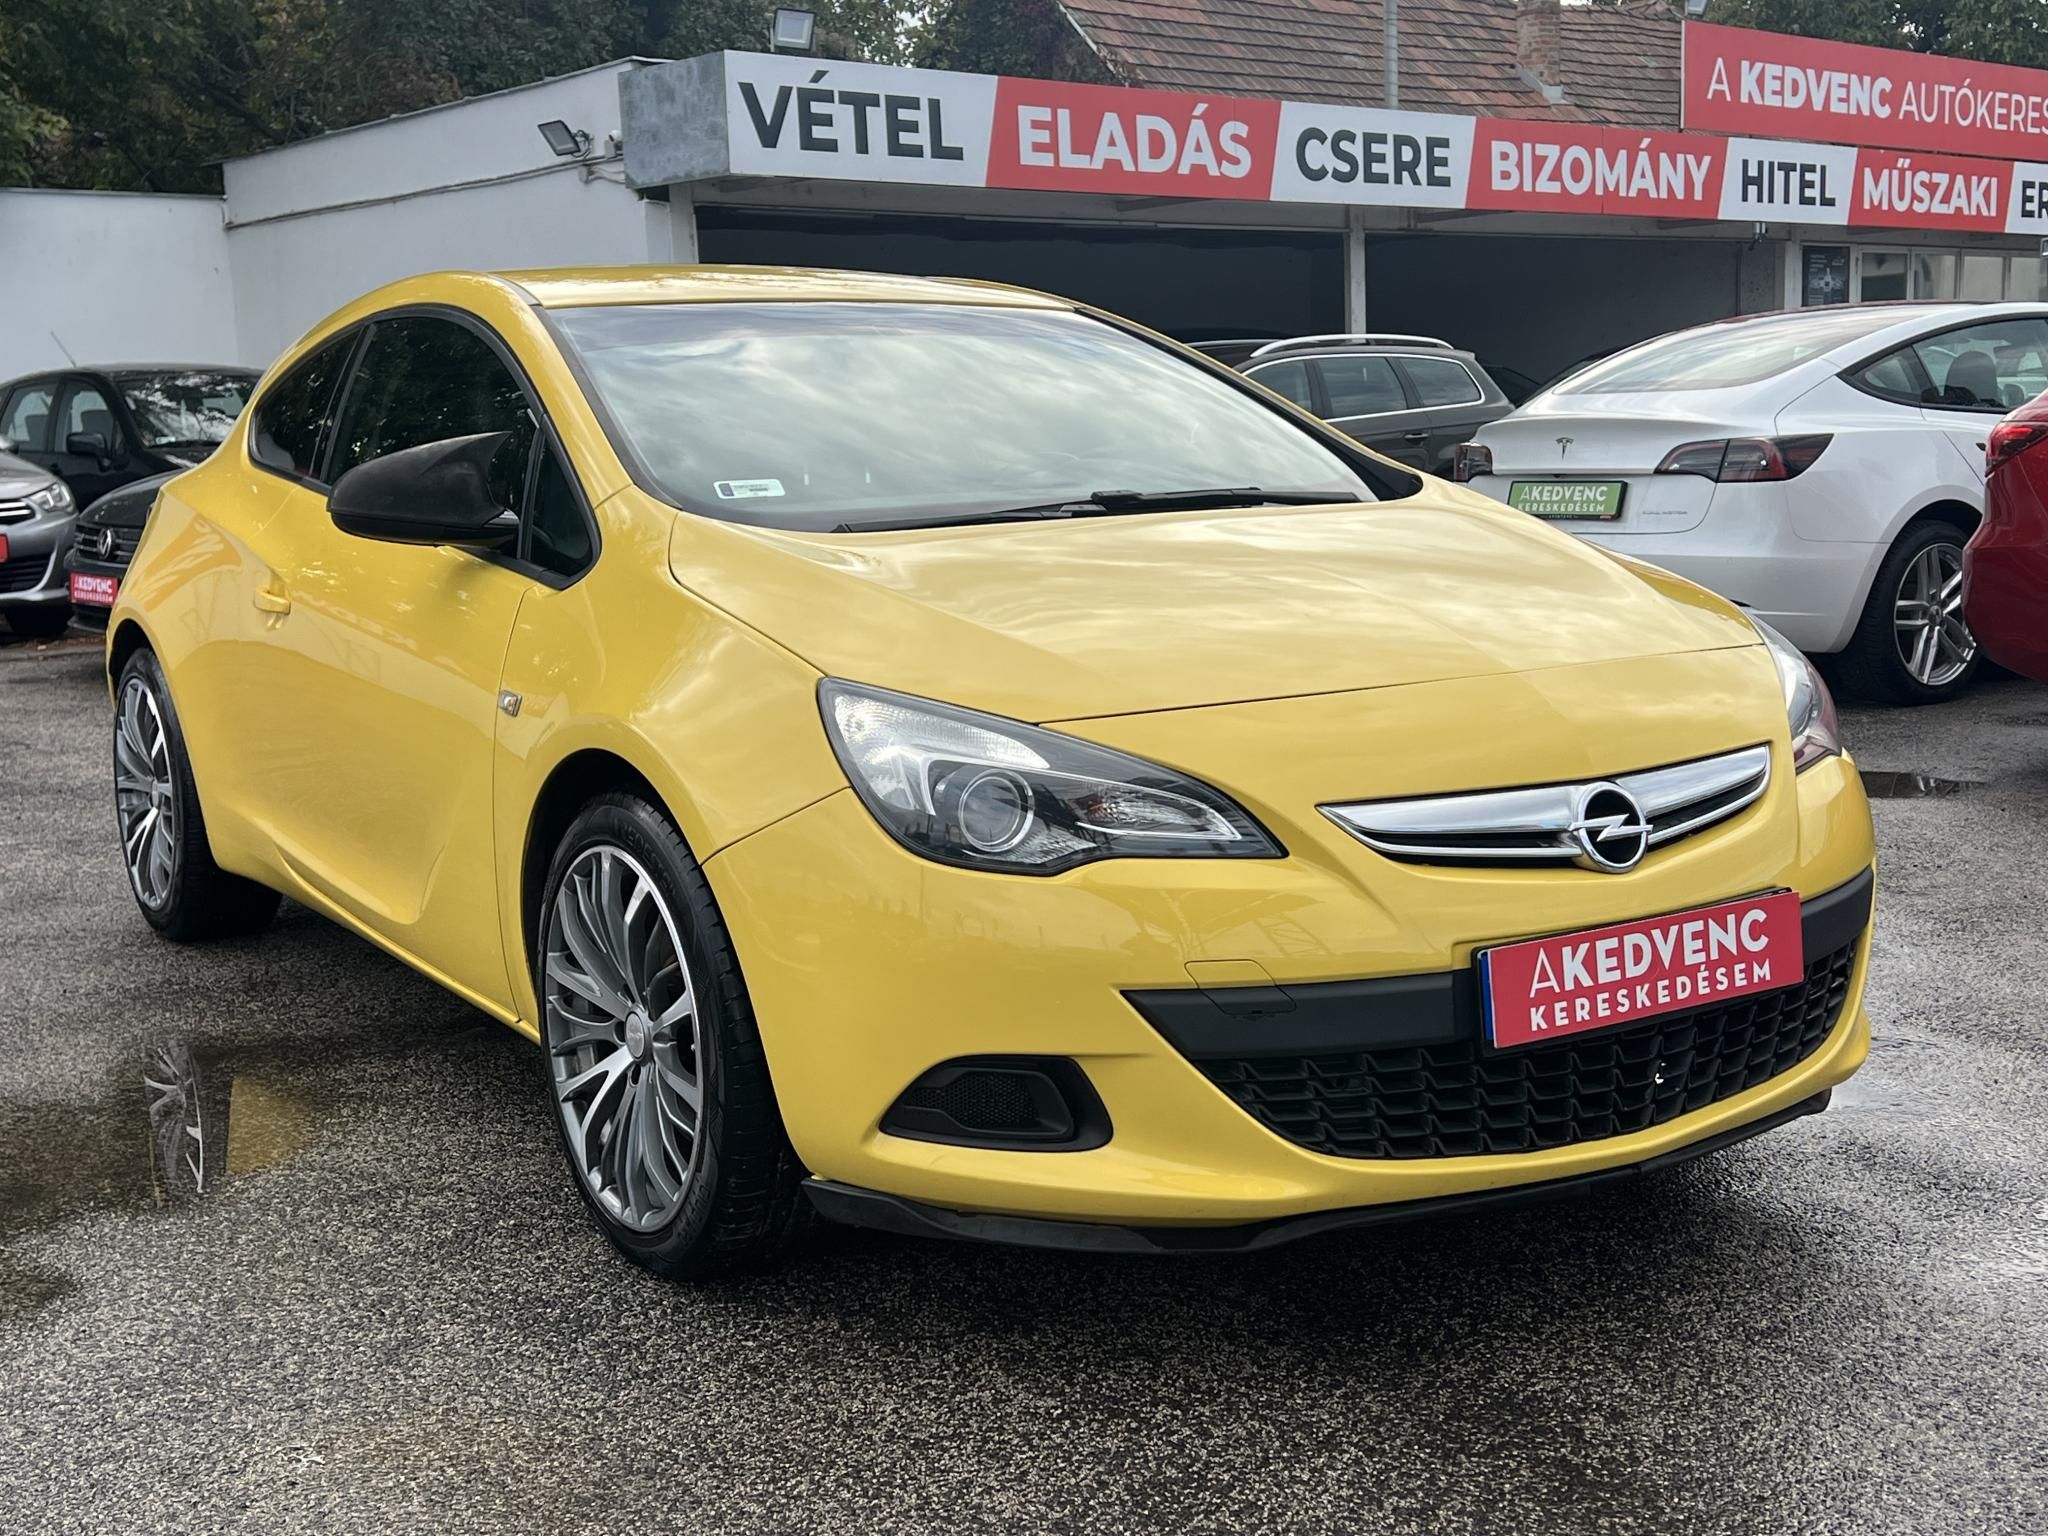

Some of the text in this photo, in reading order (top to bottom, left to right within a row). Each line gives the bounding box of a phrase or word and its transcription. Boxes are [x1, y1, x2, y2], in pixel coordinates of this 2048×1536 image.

[738, 70, 964, 161] VÉTEL
[1707, 57, 1732, 102] A
[1739, 60, 1893, 119] KEDVENC
[1017, 102, 1252, 179] ELADÁS
[1295, 127, 1452, 188] CSERE
[1491, 137, 1712, 201] BIZOMÁNY
[1741, 158, 1836, 207] HITEL
[1863, 157, 1998, 217] MŰSZAKI
[1518, 501, 1605, 512] KERESKEDÉSEM
[1530, 959, 1772, 1032] KERESKEDÉSEM
